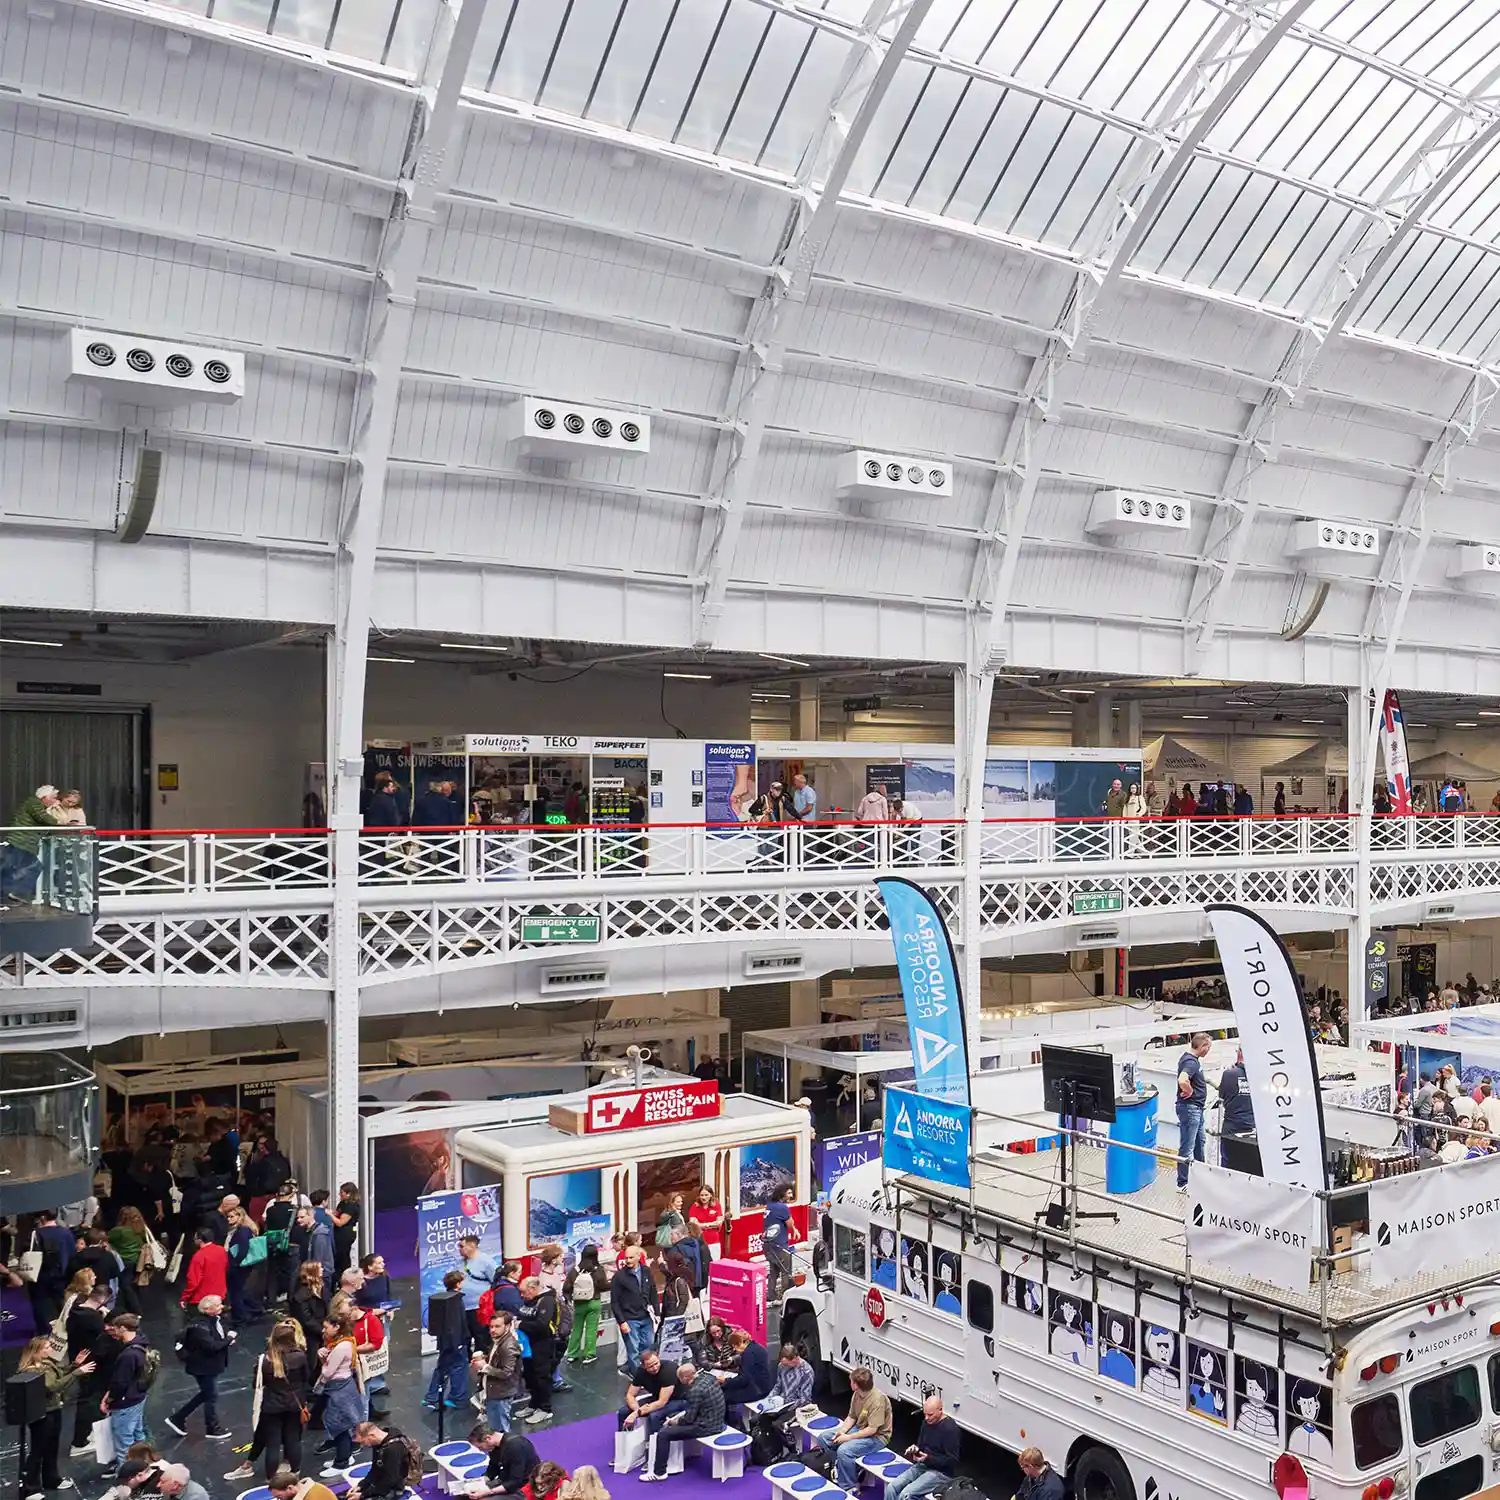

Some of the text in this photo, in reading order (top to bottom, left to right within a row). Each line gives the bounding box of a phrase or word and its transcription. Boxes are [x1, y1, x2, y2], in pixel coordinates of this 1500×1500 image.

[544, 736, 577, 747] TEKO
[594, 741, 646, 750] SUPERFEET
[708, 745, 745, 755] solutions
[524, 919, 596, 927] EMERGENCY EXIT
[644, 1088, 684, 1102] SWISS
[644, 1111, 694, 1127] RESCUE
[916, 1109, 964, 1132] ANDORRA
[916, 1123, 956, 1144] RESORTS
[837, 1150, 868, 1169] WIN
[426, 1215, 464, 1232] MEET
[1397, 1197, 1500, 1236] MAISON SPORT
[426, 1223, 488, 1244] CHEMMY
[1209, 1213, 1307, 1249] MAISON SPORT
[868, 1298, 883, 1317] STOP
[1417, 1327, 1478, 1357] MAISON SPORT
[854, 1348, 901, 1384] MAISON
